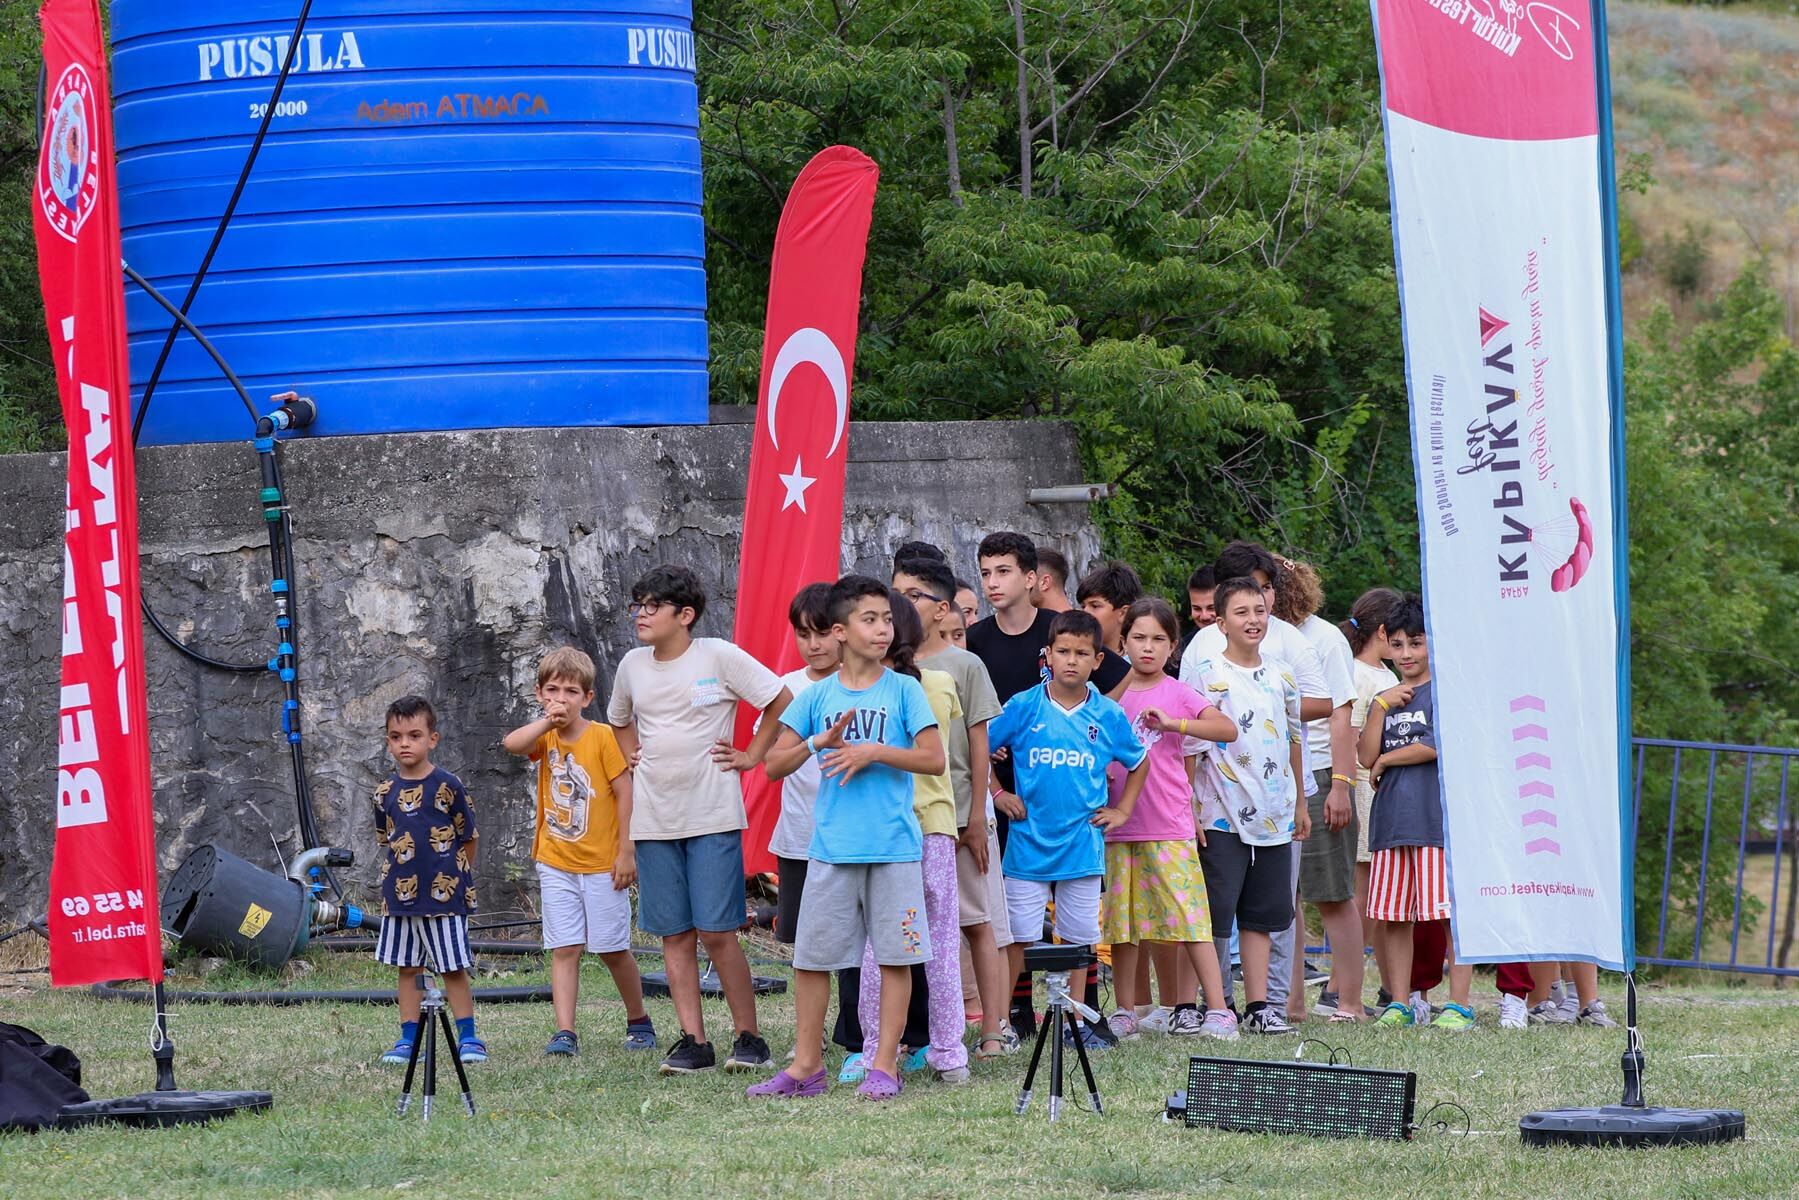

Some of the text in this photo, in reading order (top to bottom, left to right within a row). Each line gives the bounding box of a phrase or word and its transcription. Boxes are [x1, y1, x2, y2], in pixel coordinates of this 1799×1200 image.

[198, 31, 365, 81] PUSULA
[627, 27, 696, 69] PUSUL
[357, 92, 550, 122] Adem ATMACA
[1385, 710, 1427, 731] NBA
